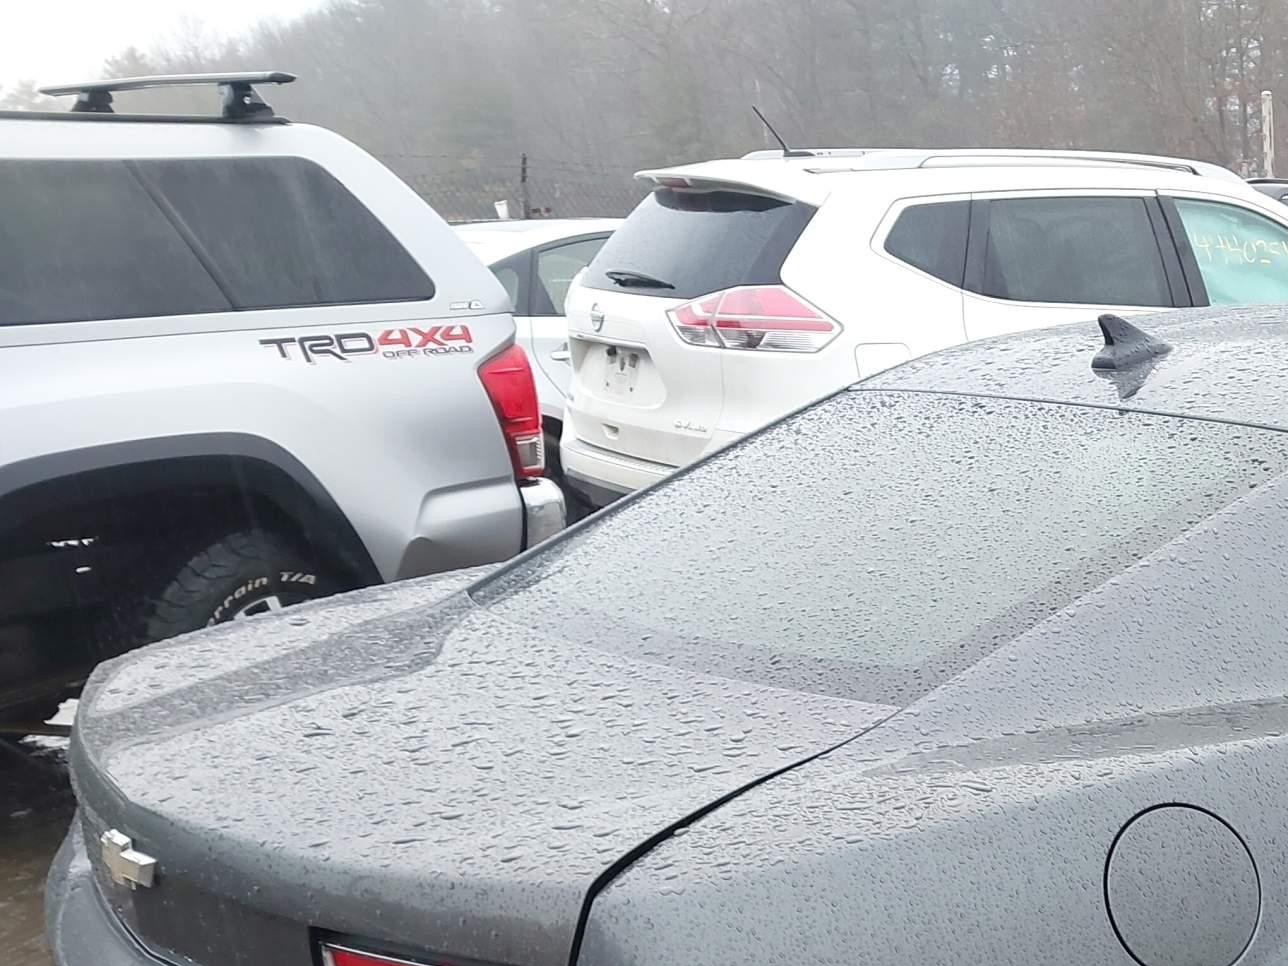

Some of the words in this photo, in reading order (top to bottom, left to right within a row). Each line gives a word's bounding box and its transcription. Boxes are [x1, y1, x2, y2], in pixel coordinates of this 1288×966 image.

[258, 332, 375, 363] TRD
[382, 350, 421, 360] OFF
[423, 345, 474, 357] ROAD
[279, 571, 317, 586] T/A
